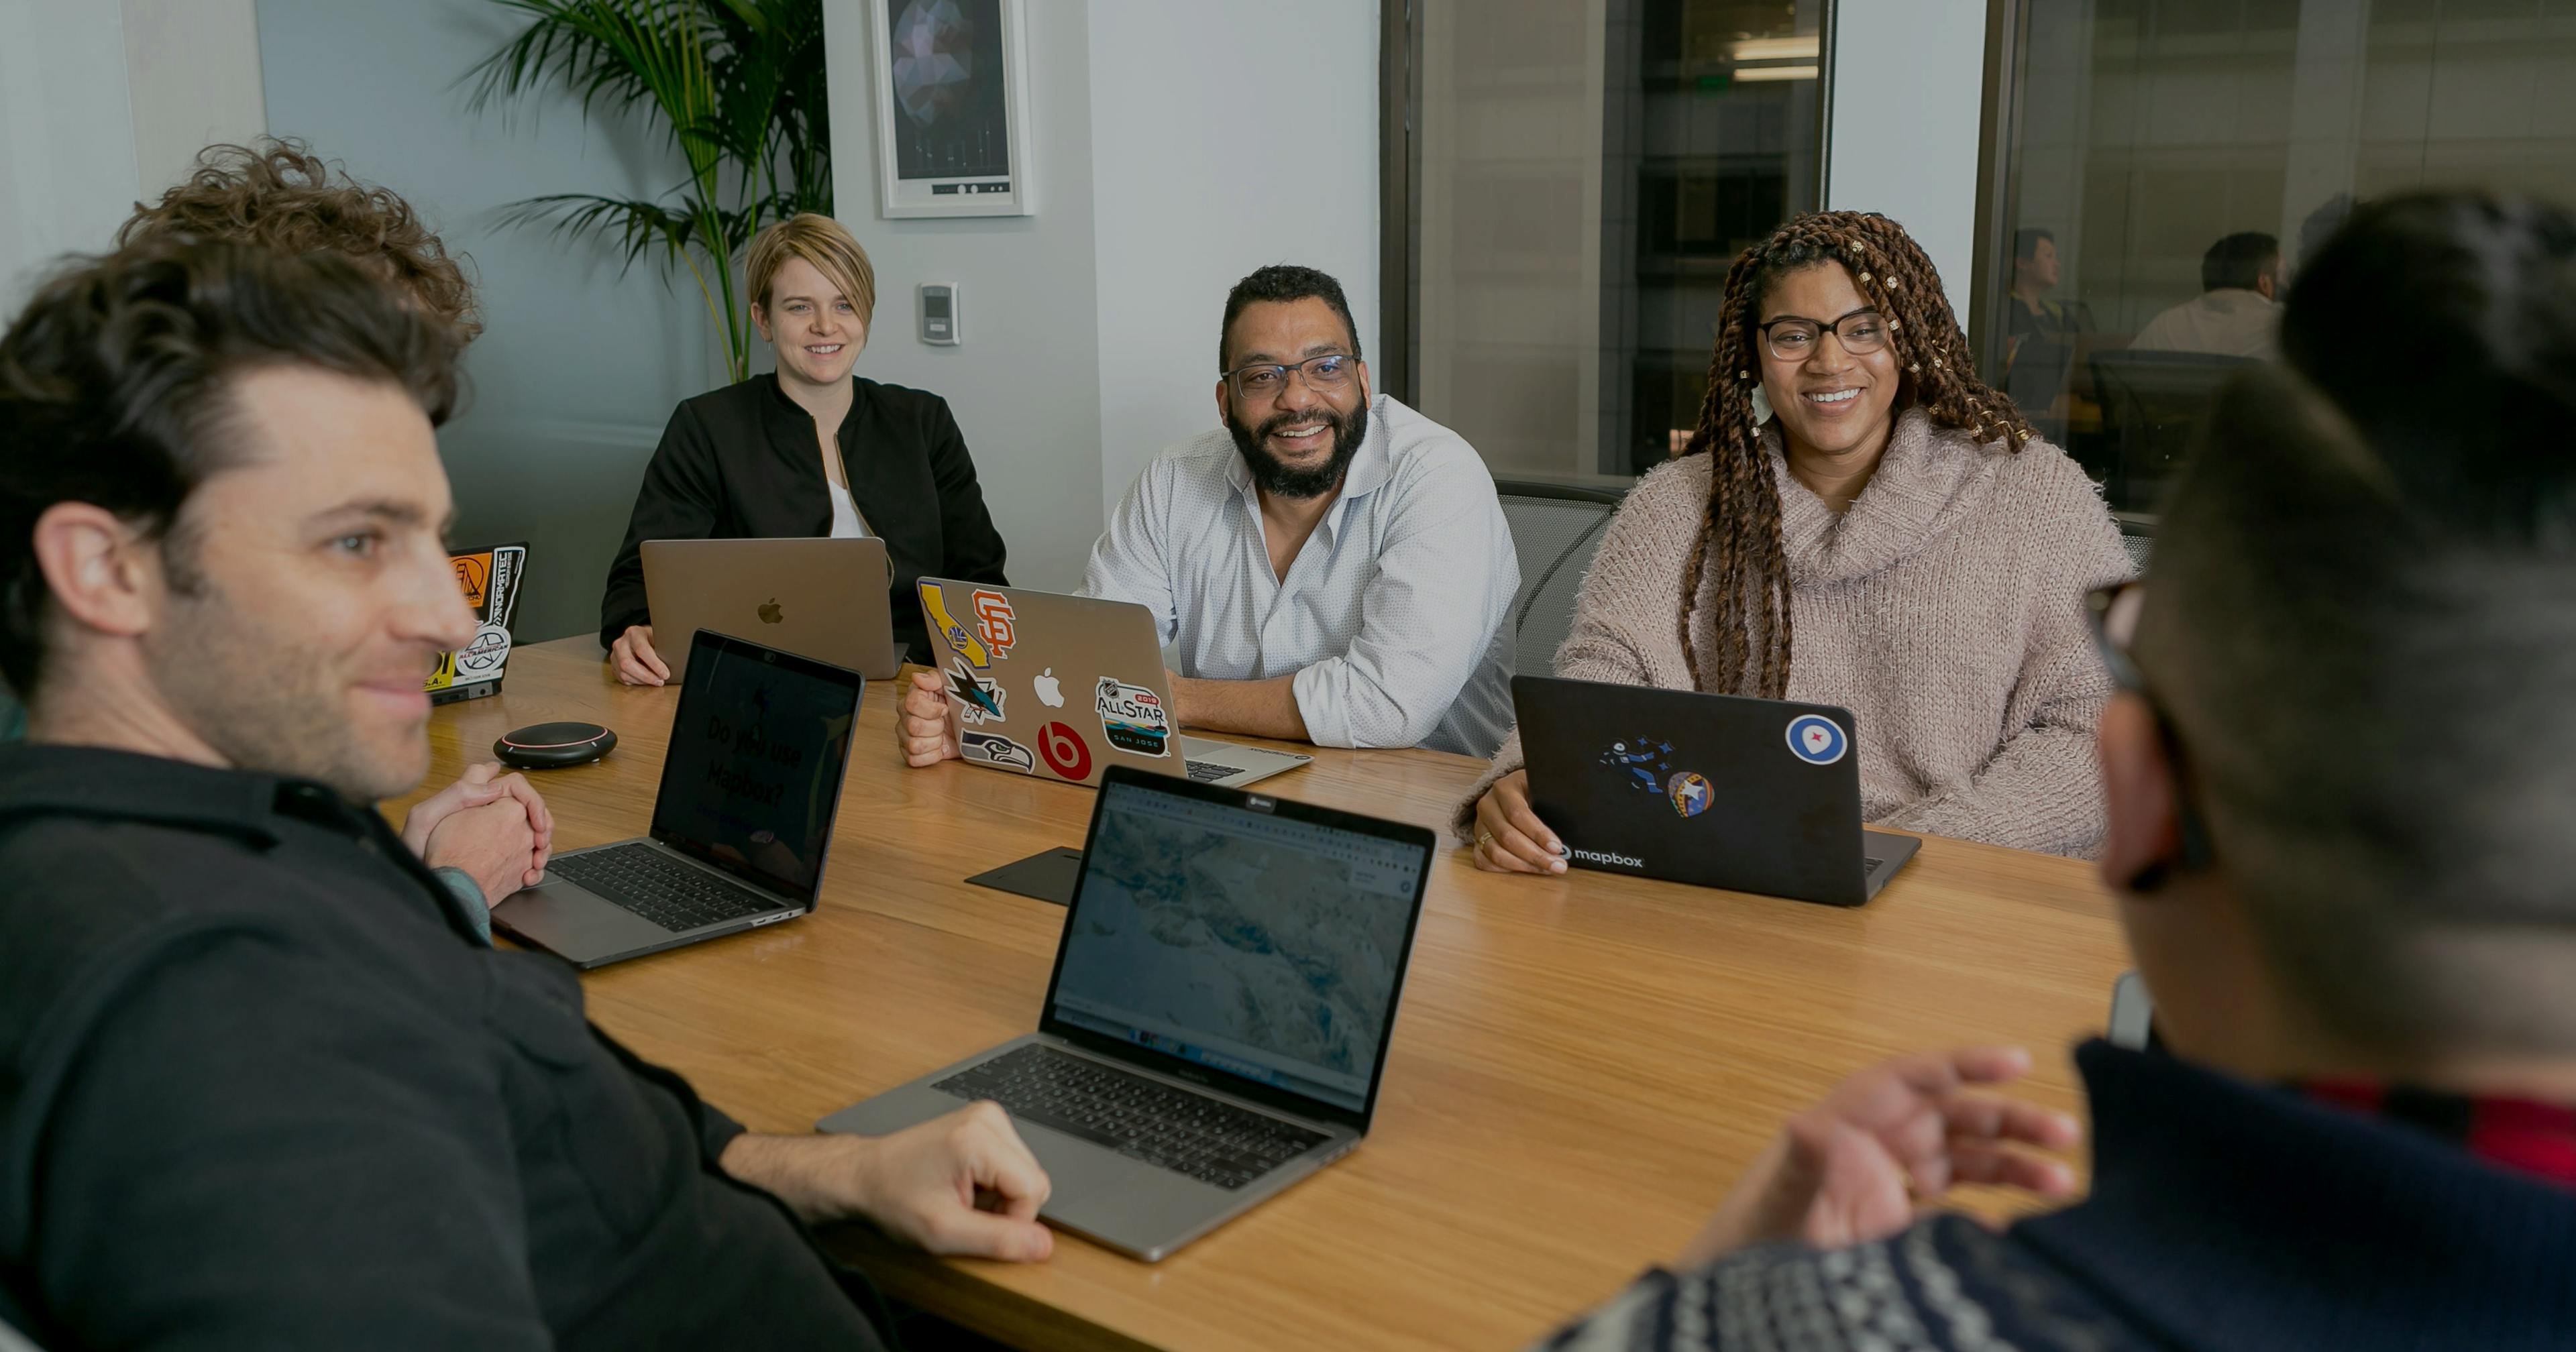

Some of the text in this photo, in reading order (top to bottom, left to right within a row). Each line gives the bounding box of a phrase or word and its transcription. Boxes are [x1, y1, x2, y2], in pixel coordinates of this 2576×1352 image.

[1136, 695, 1158, 704] 2019
[708, 716, 801, 769] Do you use
[1114, 734, 1159, 748] SAN JOSE
[706, 759, 784, 808] Mapbox?
[1574, 850, 1643, 868] mapbox
